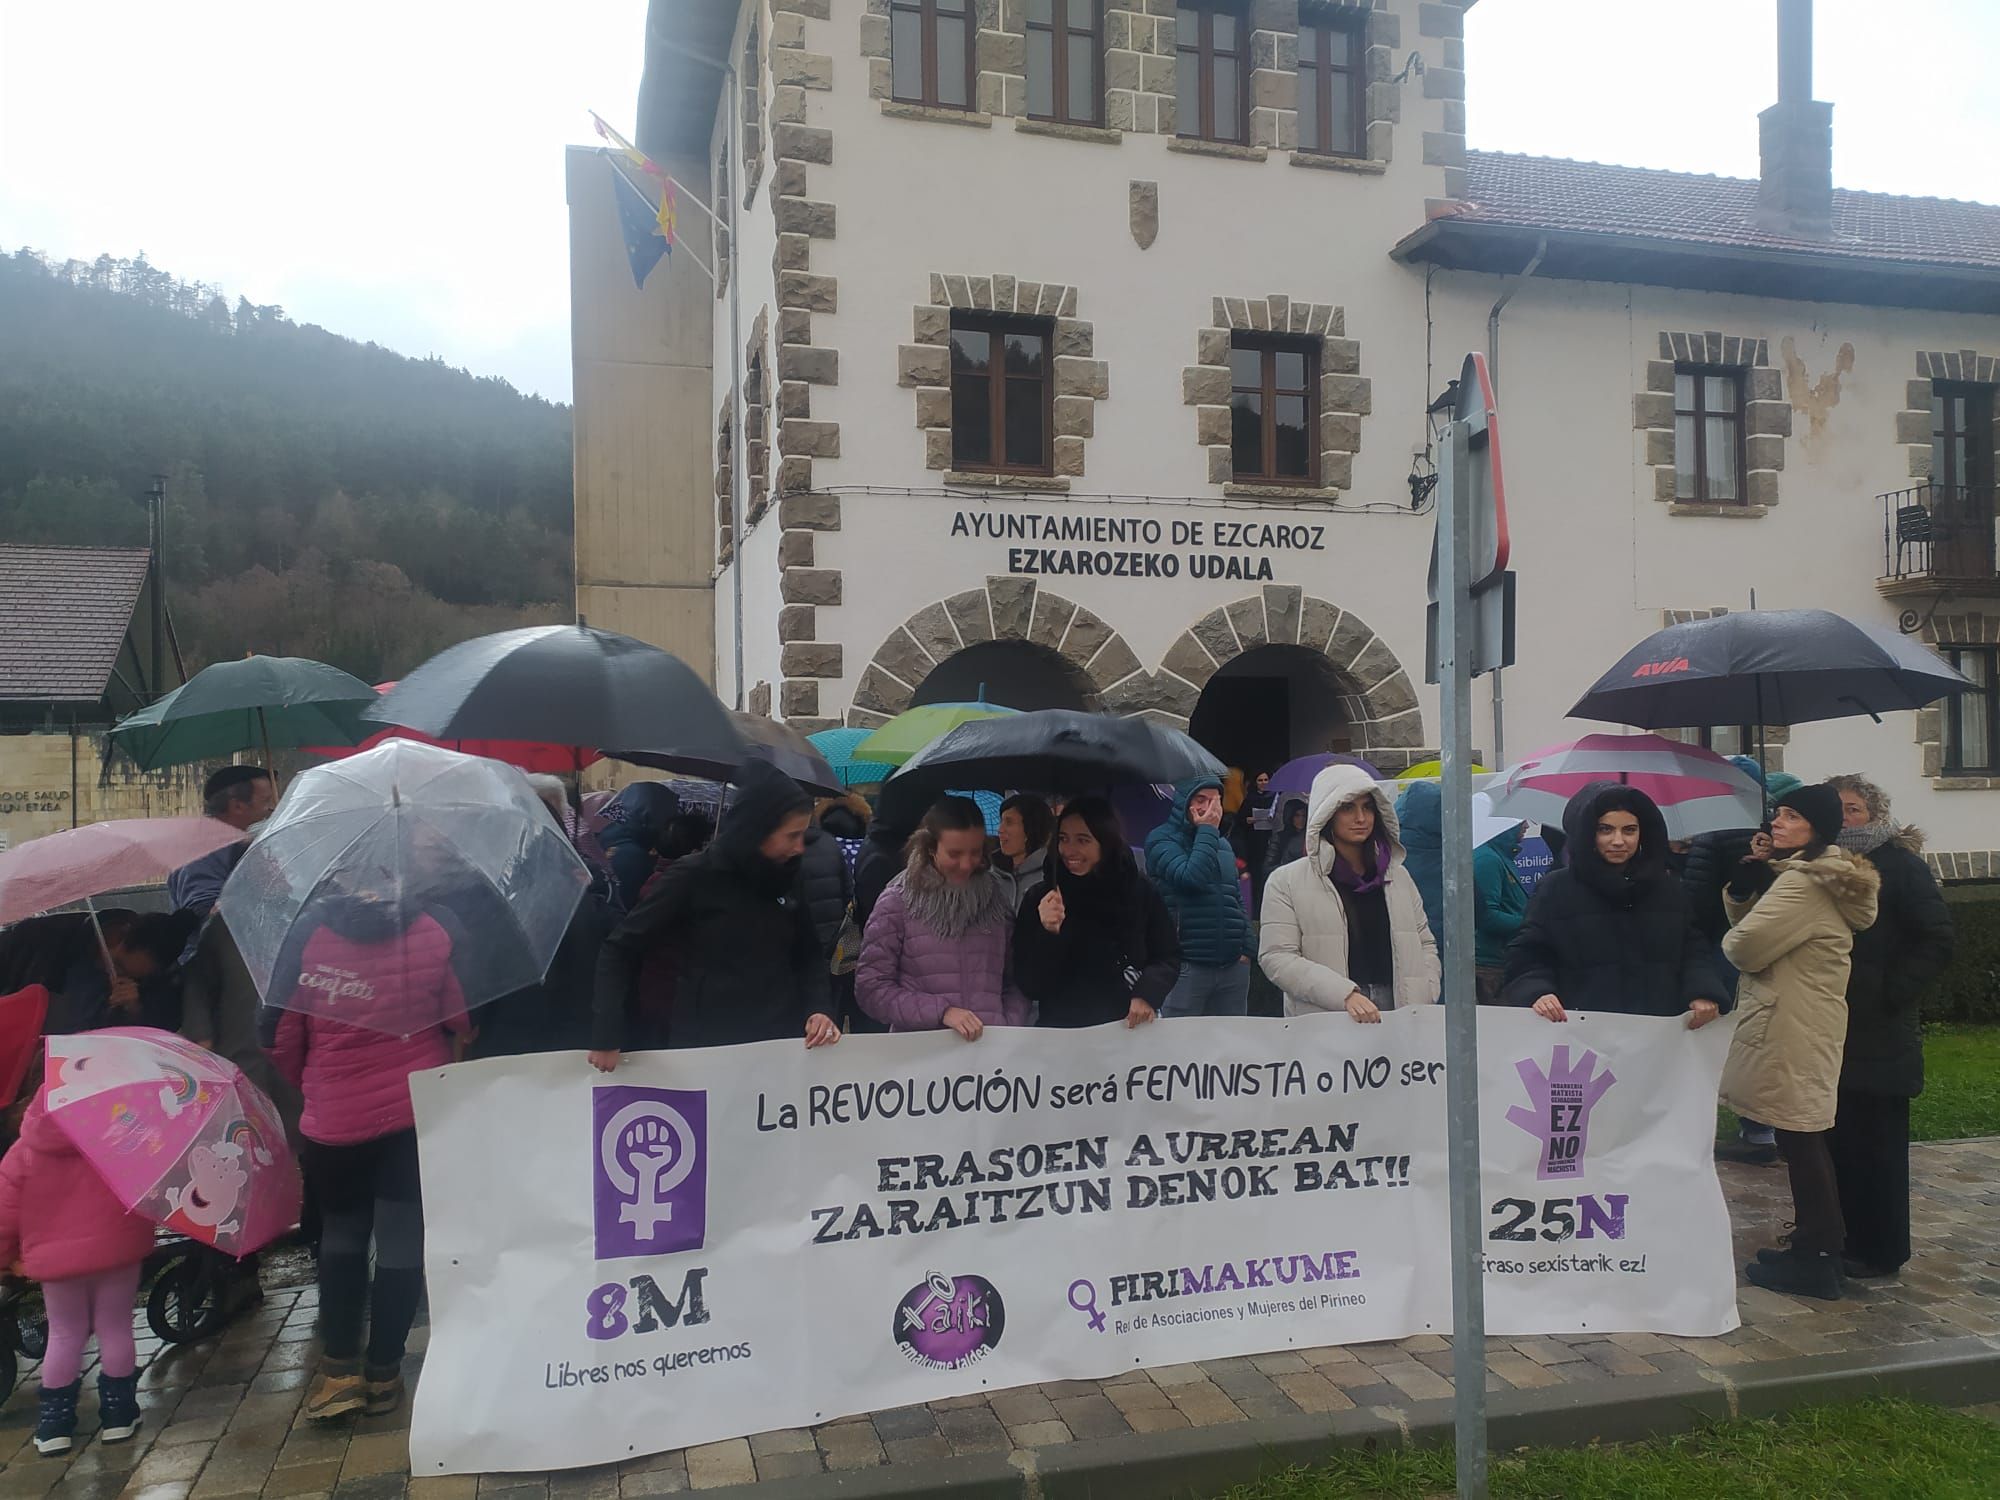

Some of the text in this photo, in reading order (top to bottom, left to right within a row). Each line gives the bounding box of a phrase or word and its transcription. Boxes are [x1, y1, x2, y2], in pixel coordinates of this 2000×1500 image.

[951, 511, 1325, 550] AYUNTAMIENTO DE EZCAROZ
[1008, 548, 1274, 580] EZKAROZEKO UDALA
[1632, 657, 1689, 677] AVIA
[15, 792, 29, 801] DE
[34, 791, 70, 801] SALUD
[1514, 855, 1554, 867] sibilida
[1520, 875, 1531, 884] ze
[757, 1056, 1445, 1131] La REVOLUCIÓN será FEMINISTA o NO ser
[1551, 1104, 1583, 1132] EZ
[877, 1122, 1359, 1192] ERASOEN AURREAN
[1549, 1136, 1580, 1160] NO
[811, 1155, 1410, 1245] ZARAITZUN DENOK BAT!!
[1489, 1194, 1629, 1243] 25N
[1109, 1250, 1360, 1307] PIRIMAKUME
[1529, 1253, 1614, 1273] sexistarik
[1619, 1254, 1646, 1273] ez!
[586, 1267, 711, 1340] 8M
[1133, 1315, 1148, 1330] de
[1152, 1302, 1234, 1328] Asociaciones
[1237, 1306, 1244, 1320] y
[1248, 1297, 1296, 1318] Mujeres
[1299, 1295, 1317, 1310] del
[1321, 1292, 1366, 1308] Pirineo
[545, 1342, 751, 1389] Libres nos queremos
[899, 1341, 993, 1371] emakume taldea
